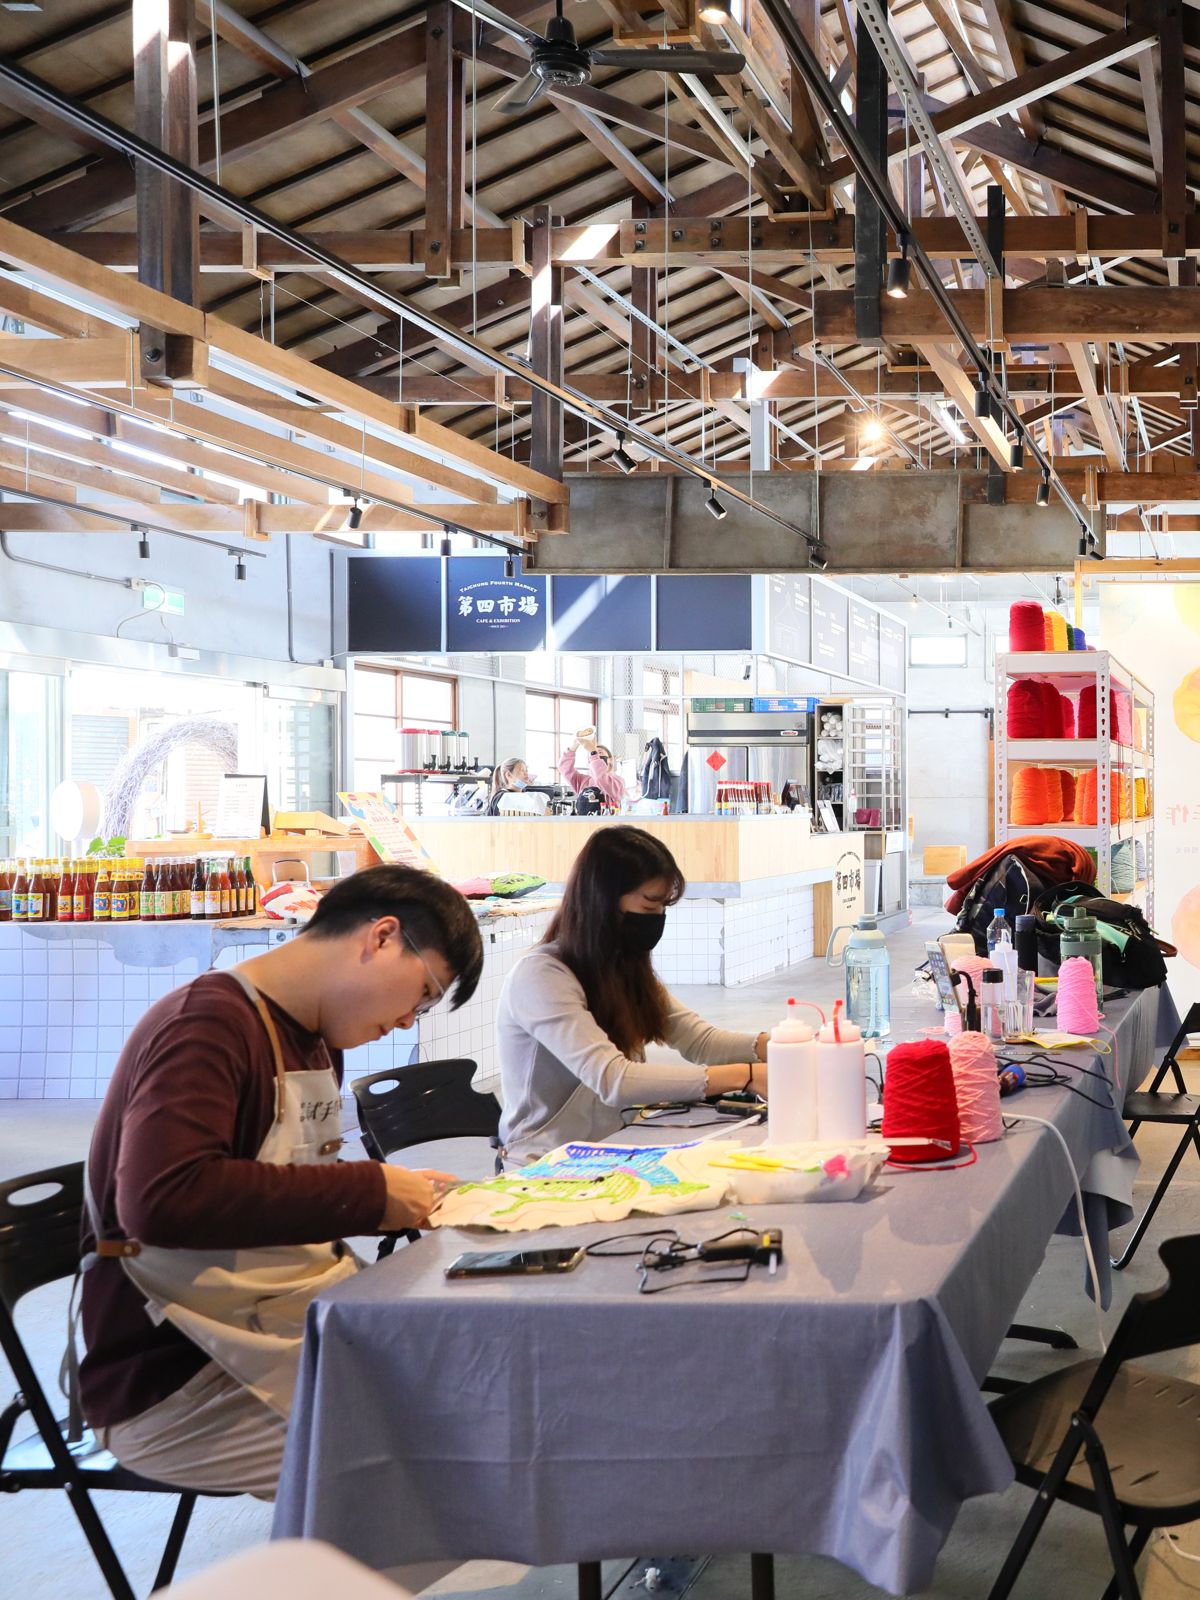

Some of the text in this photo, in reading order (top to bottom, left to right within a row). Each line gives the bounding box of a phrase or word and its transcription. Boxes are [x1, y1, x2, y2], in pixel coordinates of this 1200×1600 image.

[514, 582, 538, 593] MARKET
[458, 595, 539, 617] 第四市場
